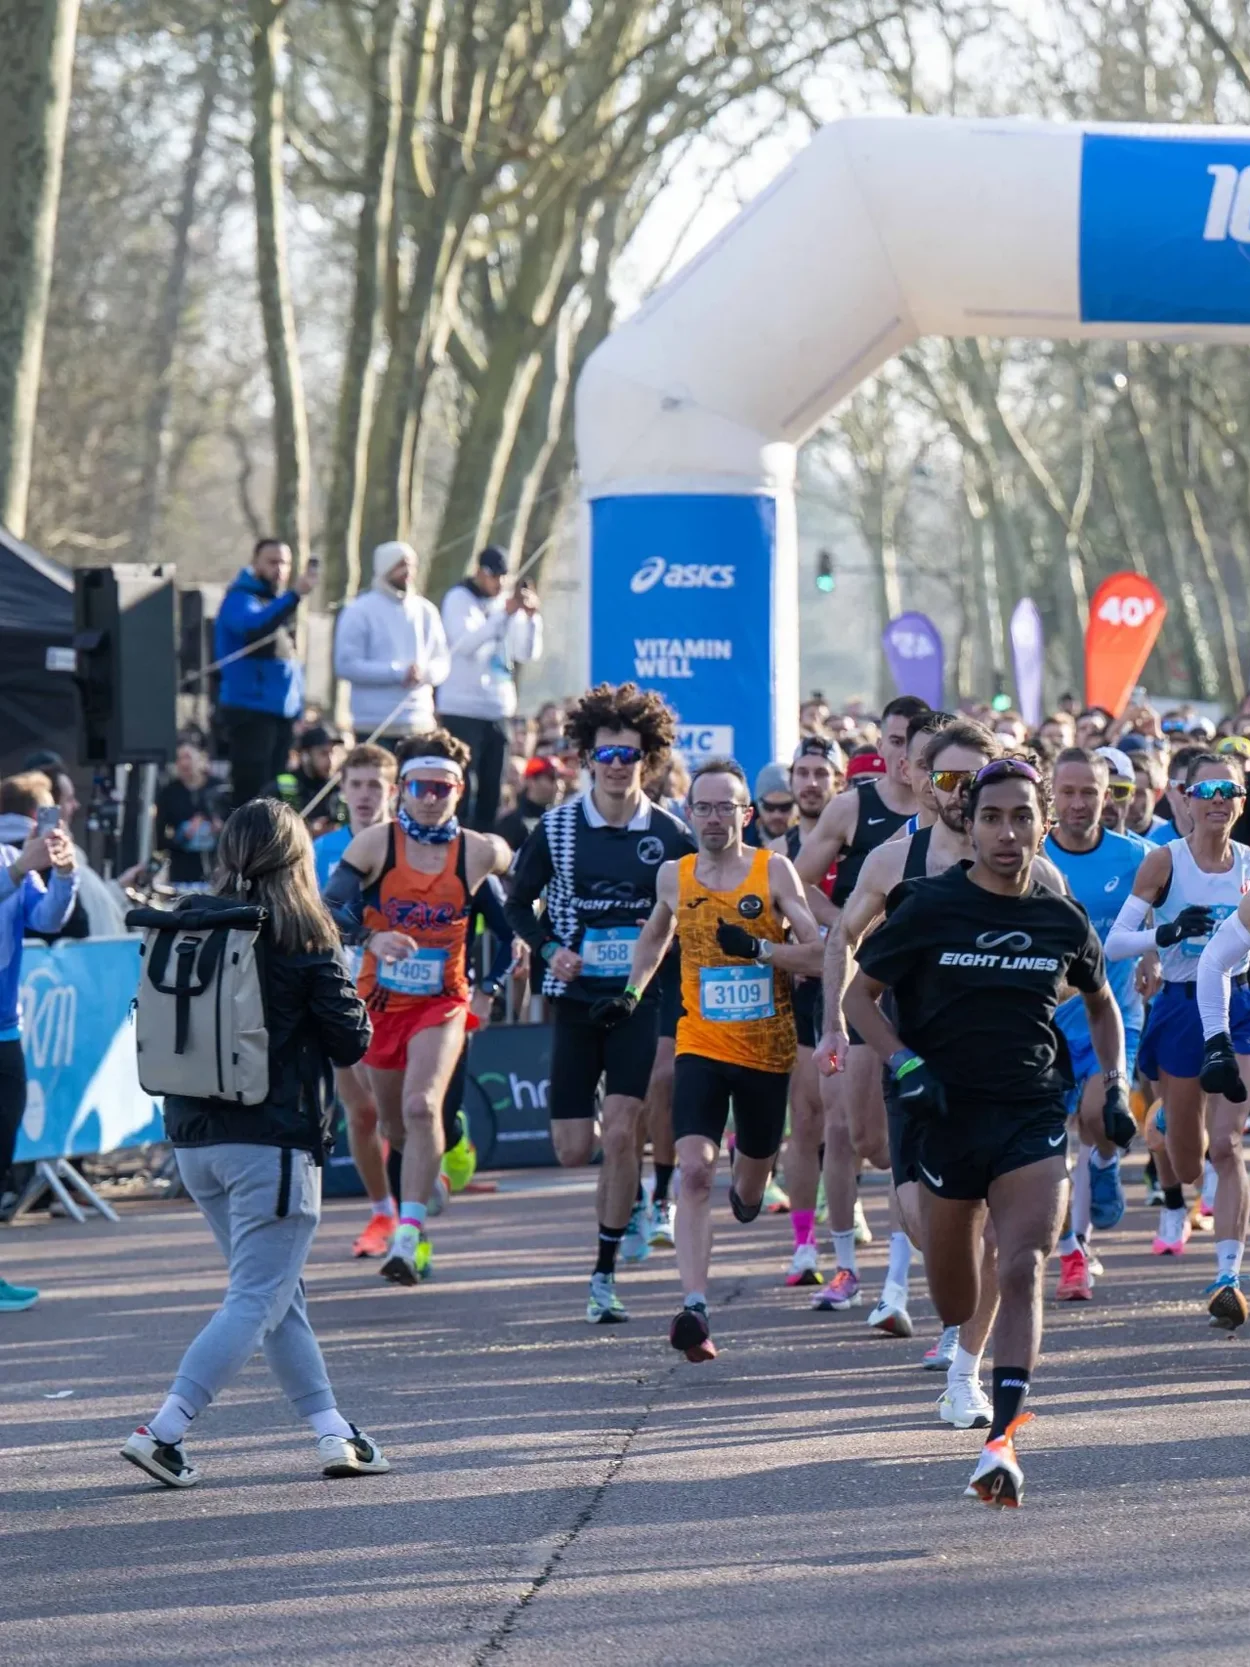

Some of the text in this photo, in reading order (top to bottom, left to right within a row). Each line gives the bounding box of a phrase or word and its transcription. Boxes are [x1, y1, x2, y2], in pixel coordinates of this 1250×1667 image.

[634, 638, 732, 659] VITAMIN
[634, 657, 694, 678] WELL
[677, 730, 713, 751] MC
[596, 943, 629, 962] 568
[939, 952, 1059, 972] EIGHT LINES
[714, 983, 762, 1005] 3109
